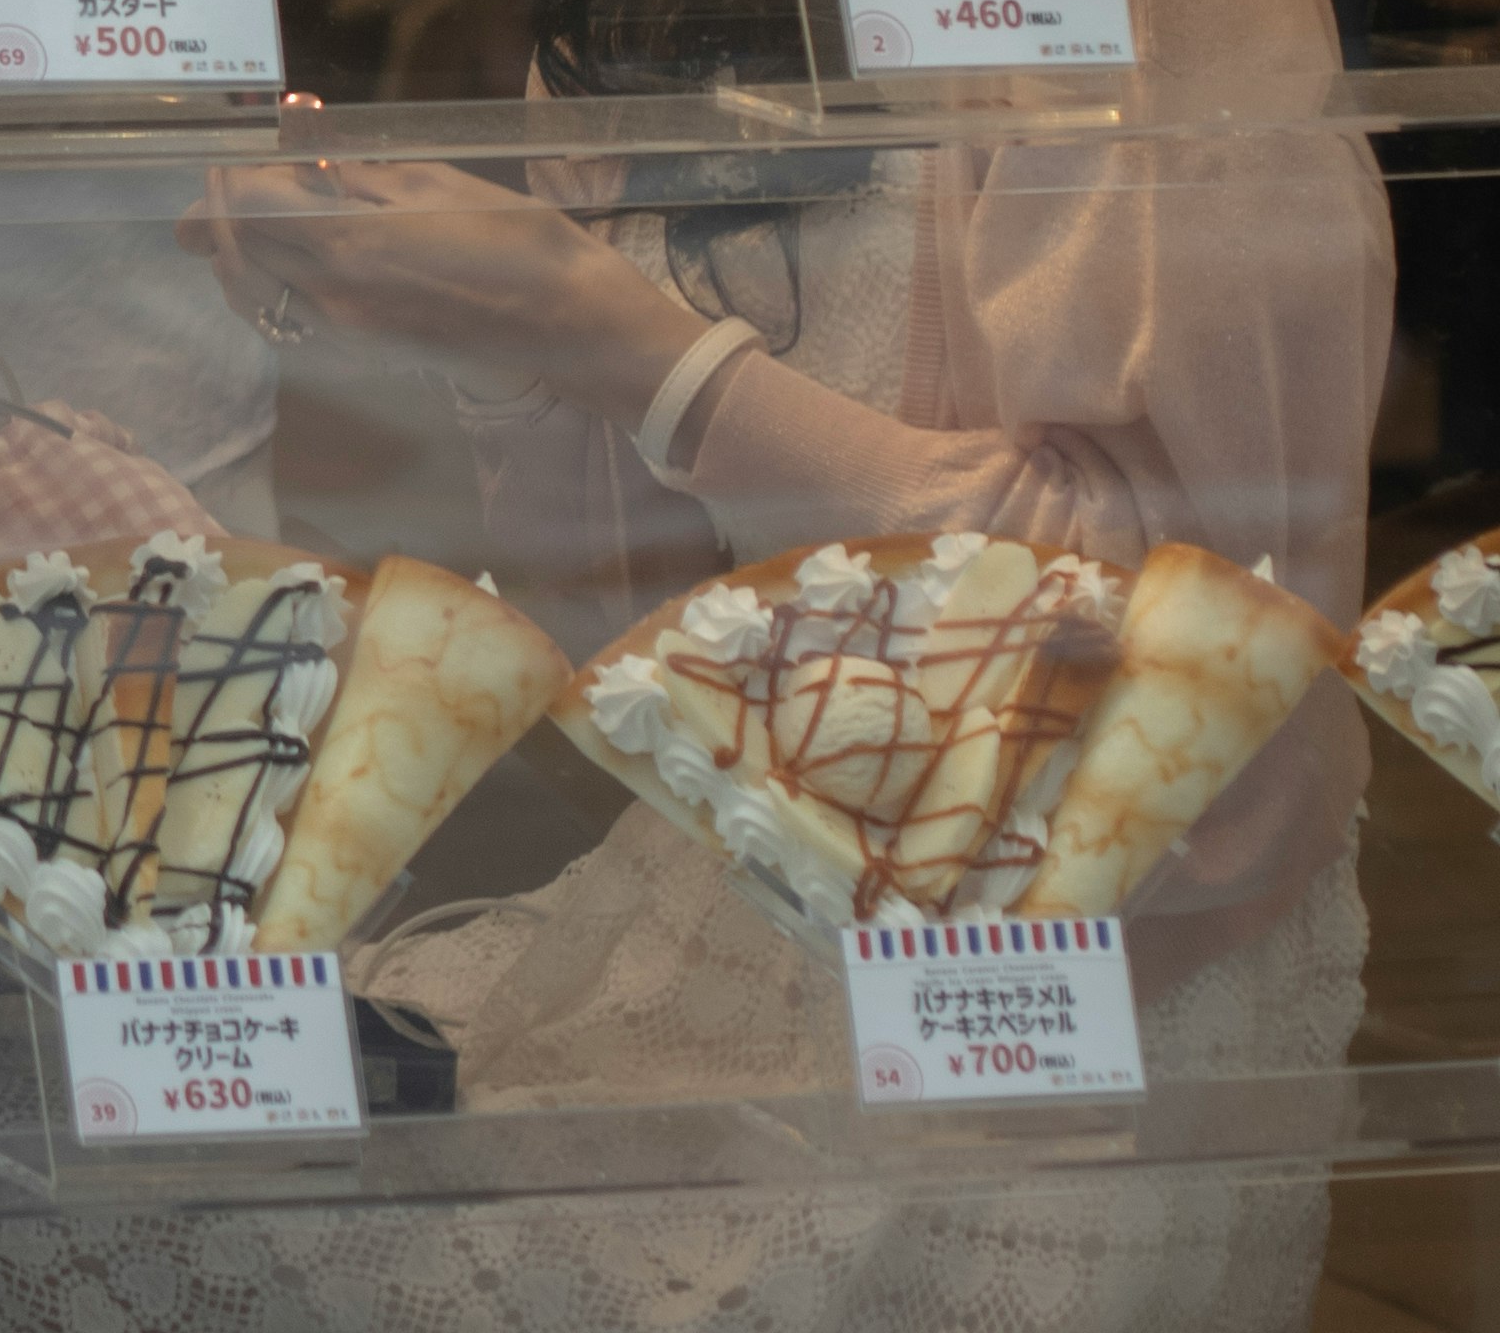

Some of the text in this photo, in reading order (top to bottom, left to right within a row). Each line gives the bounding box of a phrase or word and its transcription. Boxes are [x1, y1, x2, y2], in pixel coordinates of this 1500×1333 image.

[937, 0, 1022, 29] ¥460
[76, 27, 166, 56] ¥500
[873, 36, 885, 52] 2
[0, 49, 25, 65] 69
[914, 985, 1075, 1014] バナナキャラメル
[121, 1017, 299, 1045] バナナチョコケーキ
[920, 1012, 1076, 1041] ケーキスペシャル
[176, 1047, 252, 1070] クリーム
[949, 1043, 1036, 1075] ¥700
[164, 1079, 251, 1111] ¥630
